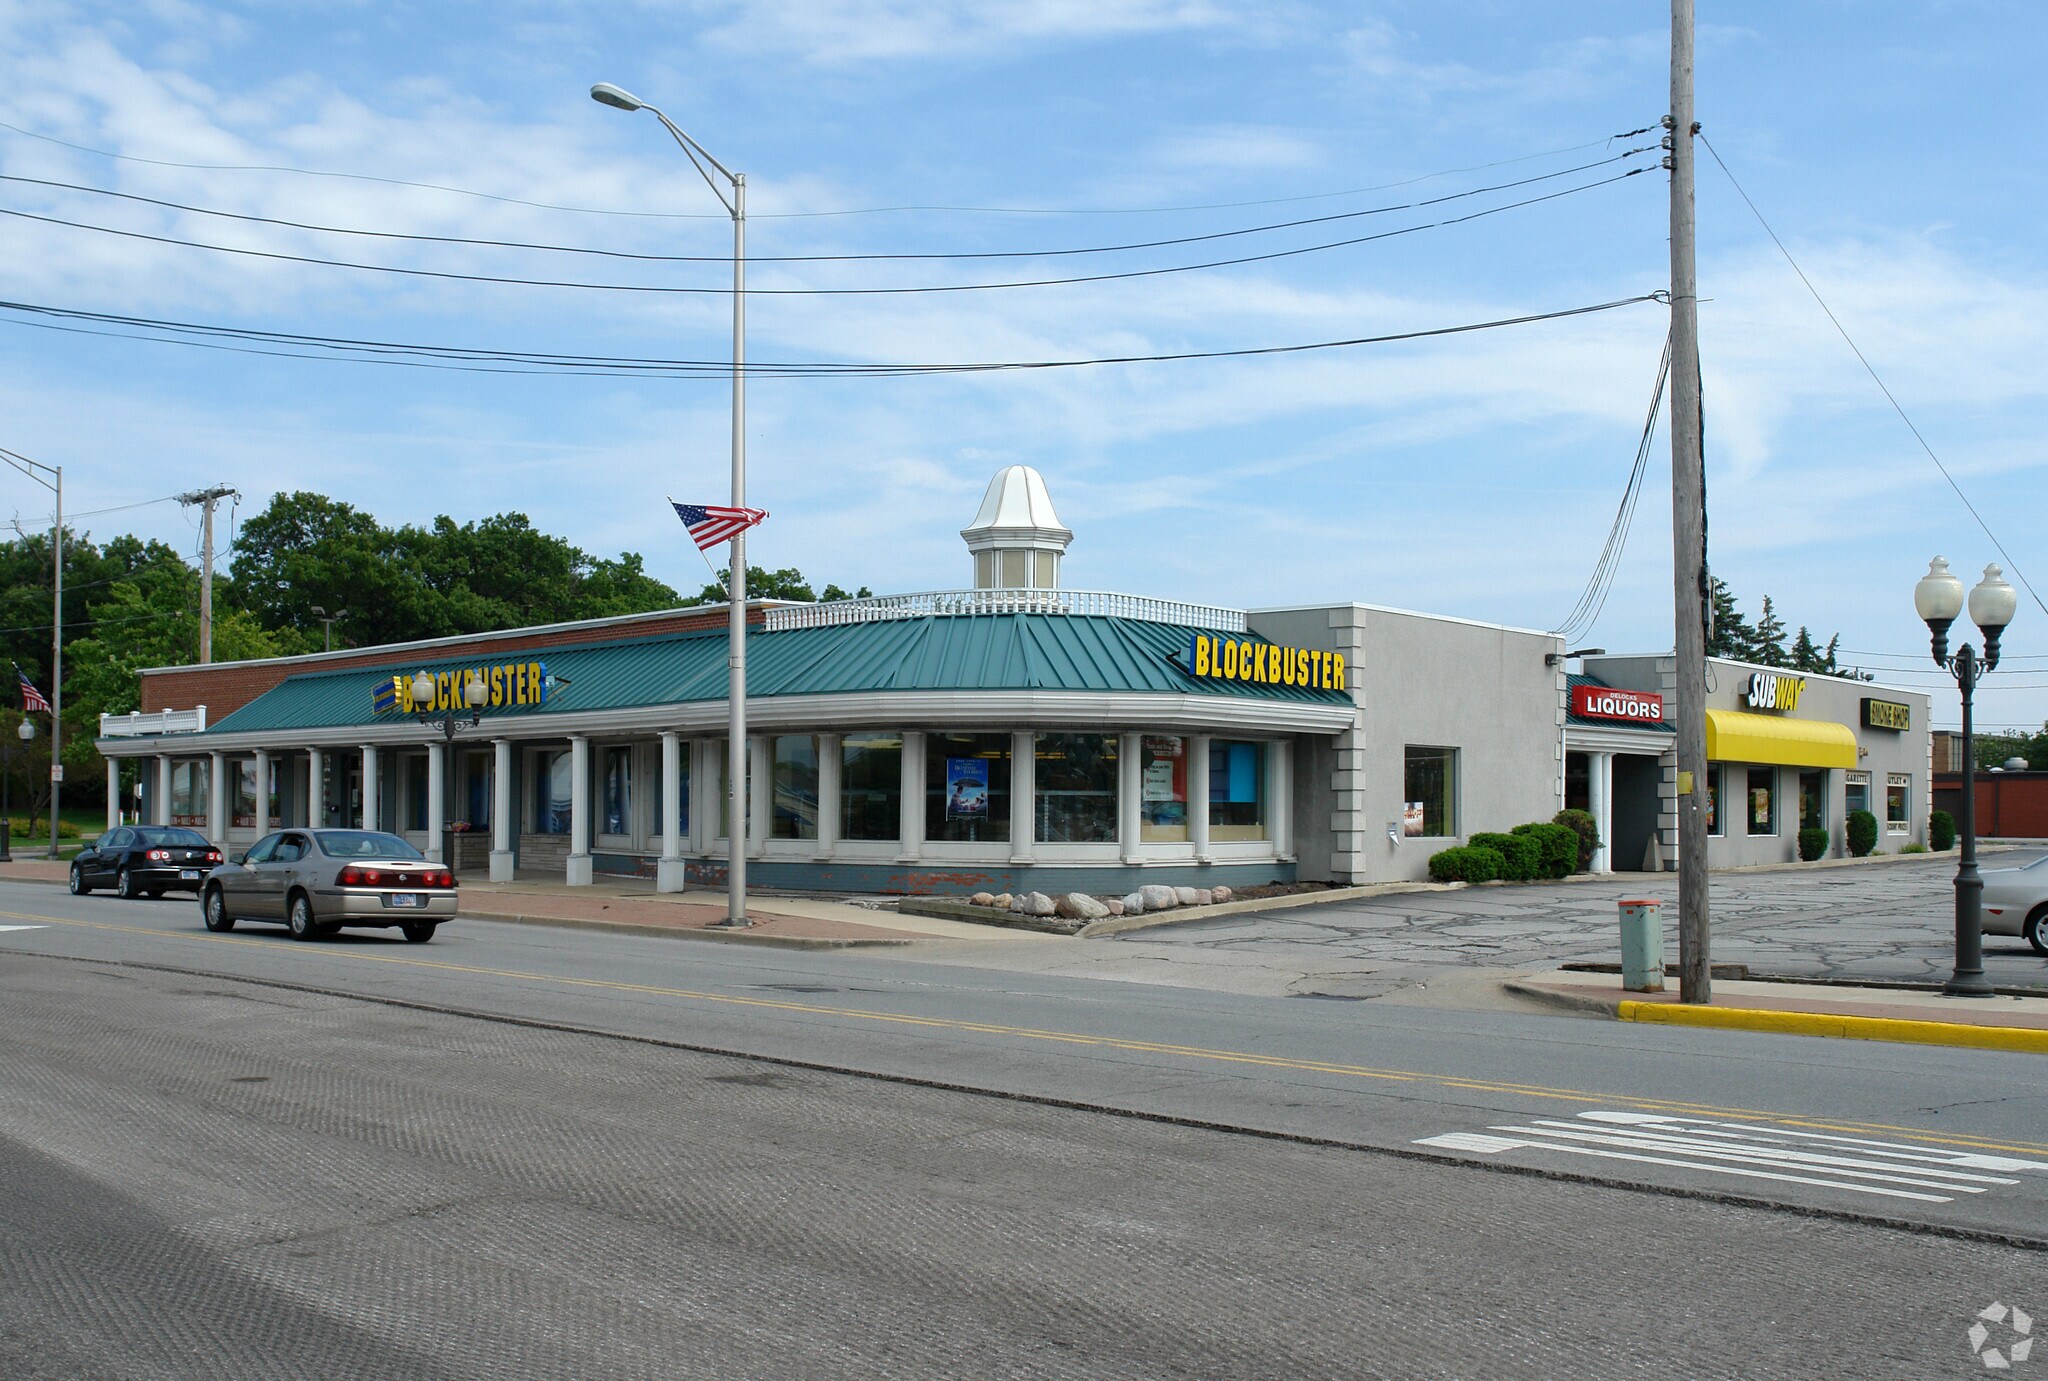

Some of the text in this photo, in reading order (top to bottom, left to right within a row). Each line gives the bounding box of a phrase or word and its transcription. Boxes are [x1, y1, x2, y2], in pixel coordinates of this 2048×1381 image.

[1195, 635, 1345, 690] BLOCKBUSTER
[403, 662, 541, 713] BOCKUSTER
[1610, 692, 1637, 701] DELOCKS
[1748, 673, 1806, 711] SUBWAY
[1587, 696, 1660, 719] LIQUORS
[1872, 702, 1908, 728] SMOKE SHOP
